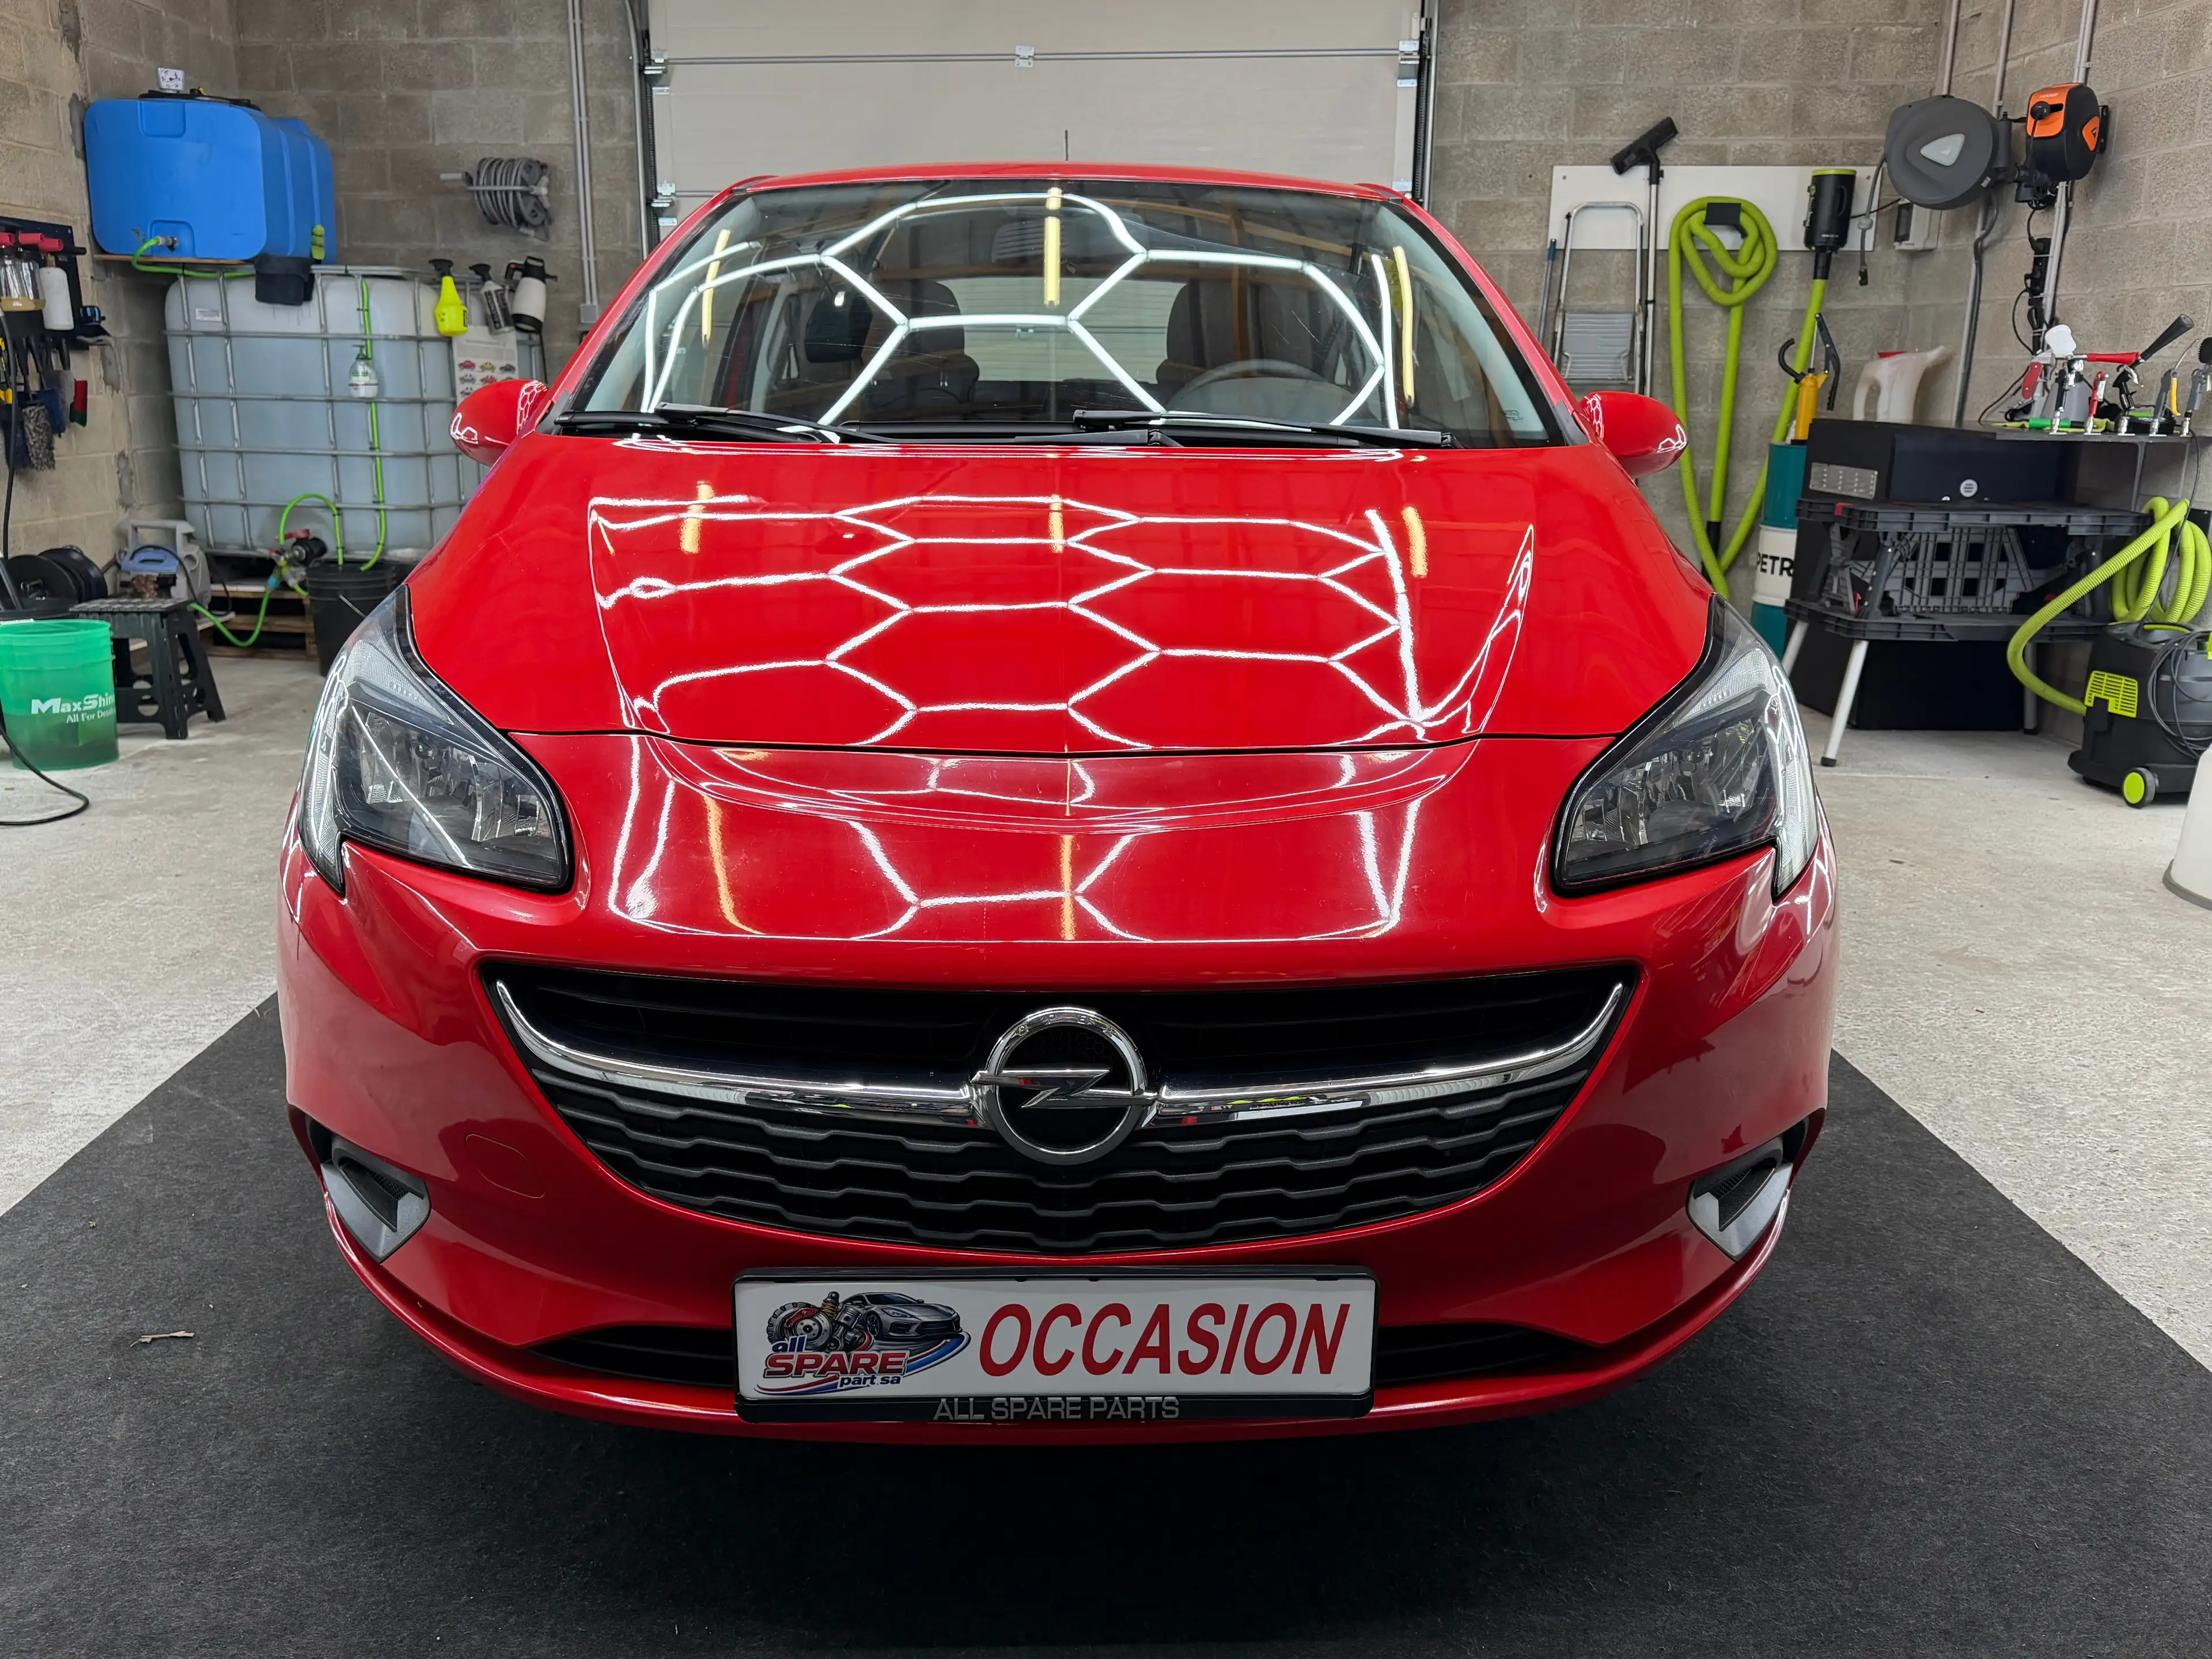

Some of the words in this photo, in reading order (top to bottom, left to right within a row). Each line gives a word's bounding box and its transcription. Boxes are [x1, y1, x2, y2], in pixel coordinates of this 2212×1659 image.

[66, 714, 79, 724] All
[772, 1335, 806, 1353] all
[979, 1302, 1350, 1377] OCCASION
[764, 1351, 910, 1377] SPARE
[933, 1397, 985, 1421] ALL
[991, 1397, 1081, 1420] SPARE
[1090, 1396, 1179, 1419] PARTS
